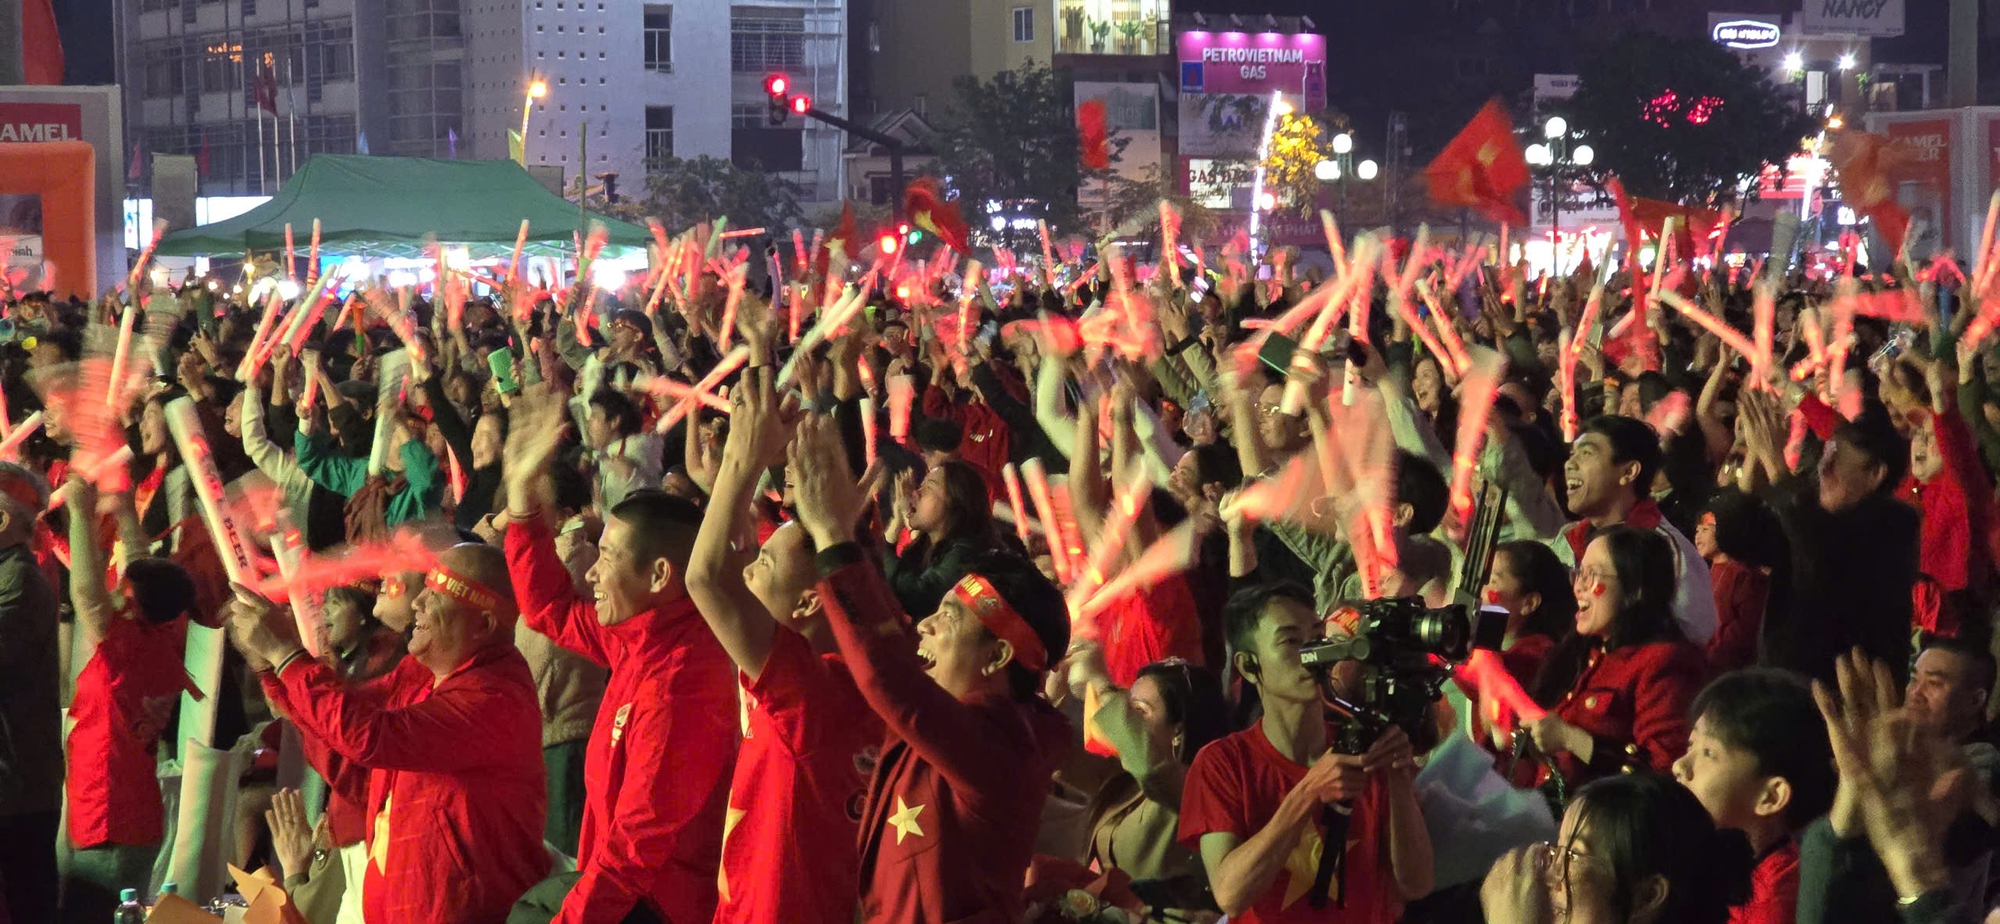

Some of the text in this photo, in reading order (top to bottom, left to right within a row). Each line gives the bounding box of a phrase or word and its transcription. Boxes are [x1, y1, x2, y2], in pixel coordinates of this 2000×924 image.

[1821, 0, 1888, 18] NANCY
[1202, 48, 1303, 63] PETROVIETNAM
[1240, 65, 1267, 79] GAS
[223, 516, 248, 569] BEER
[446, 576, 470, 598] VIỆT
